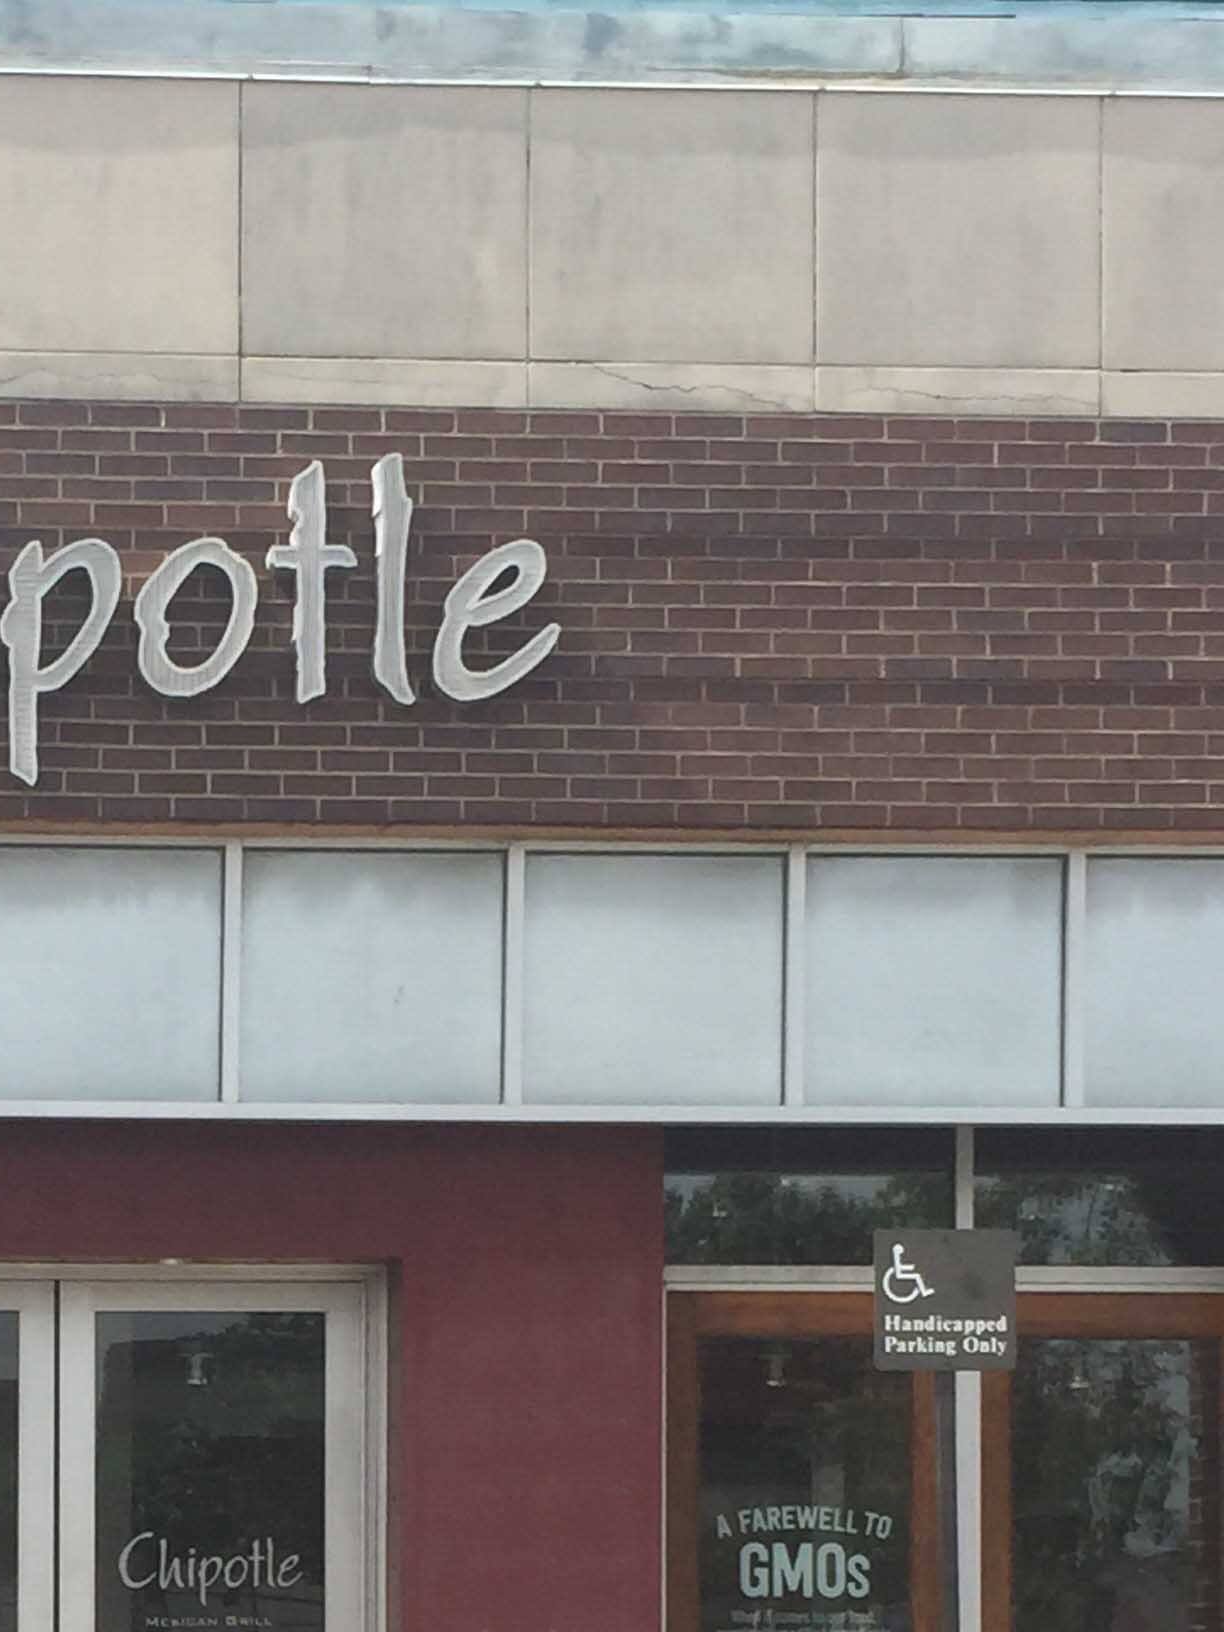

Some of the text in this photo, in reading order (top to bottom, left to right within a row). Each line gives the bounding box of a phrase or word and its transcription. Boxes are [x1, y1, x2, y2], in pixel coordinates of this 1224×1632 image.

[884, 1314, 1008, 1335] Handicapped
[884, 1336, 1008, 1356] Parking Only
[716, 1505, 894, 1539] A FAREWELL TO
[118, 1531, 305, 1606] Chipotle
[739, 1541, 872, 1598] GMOs
